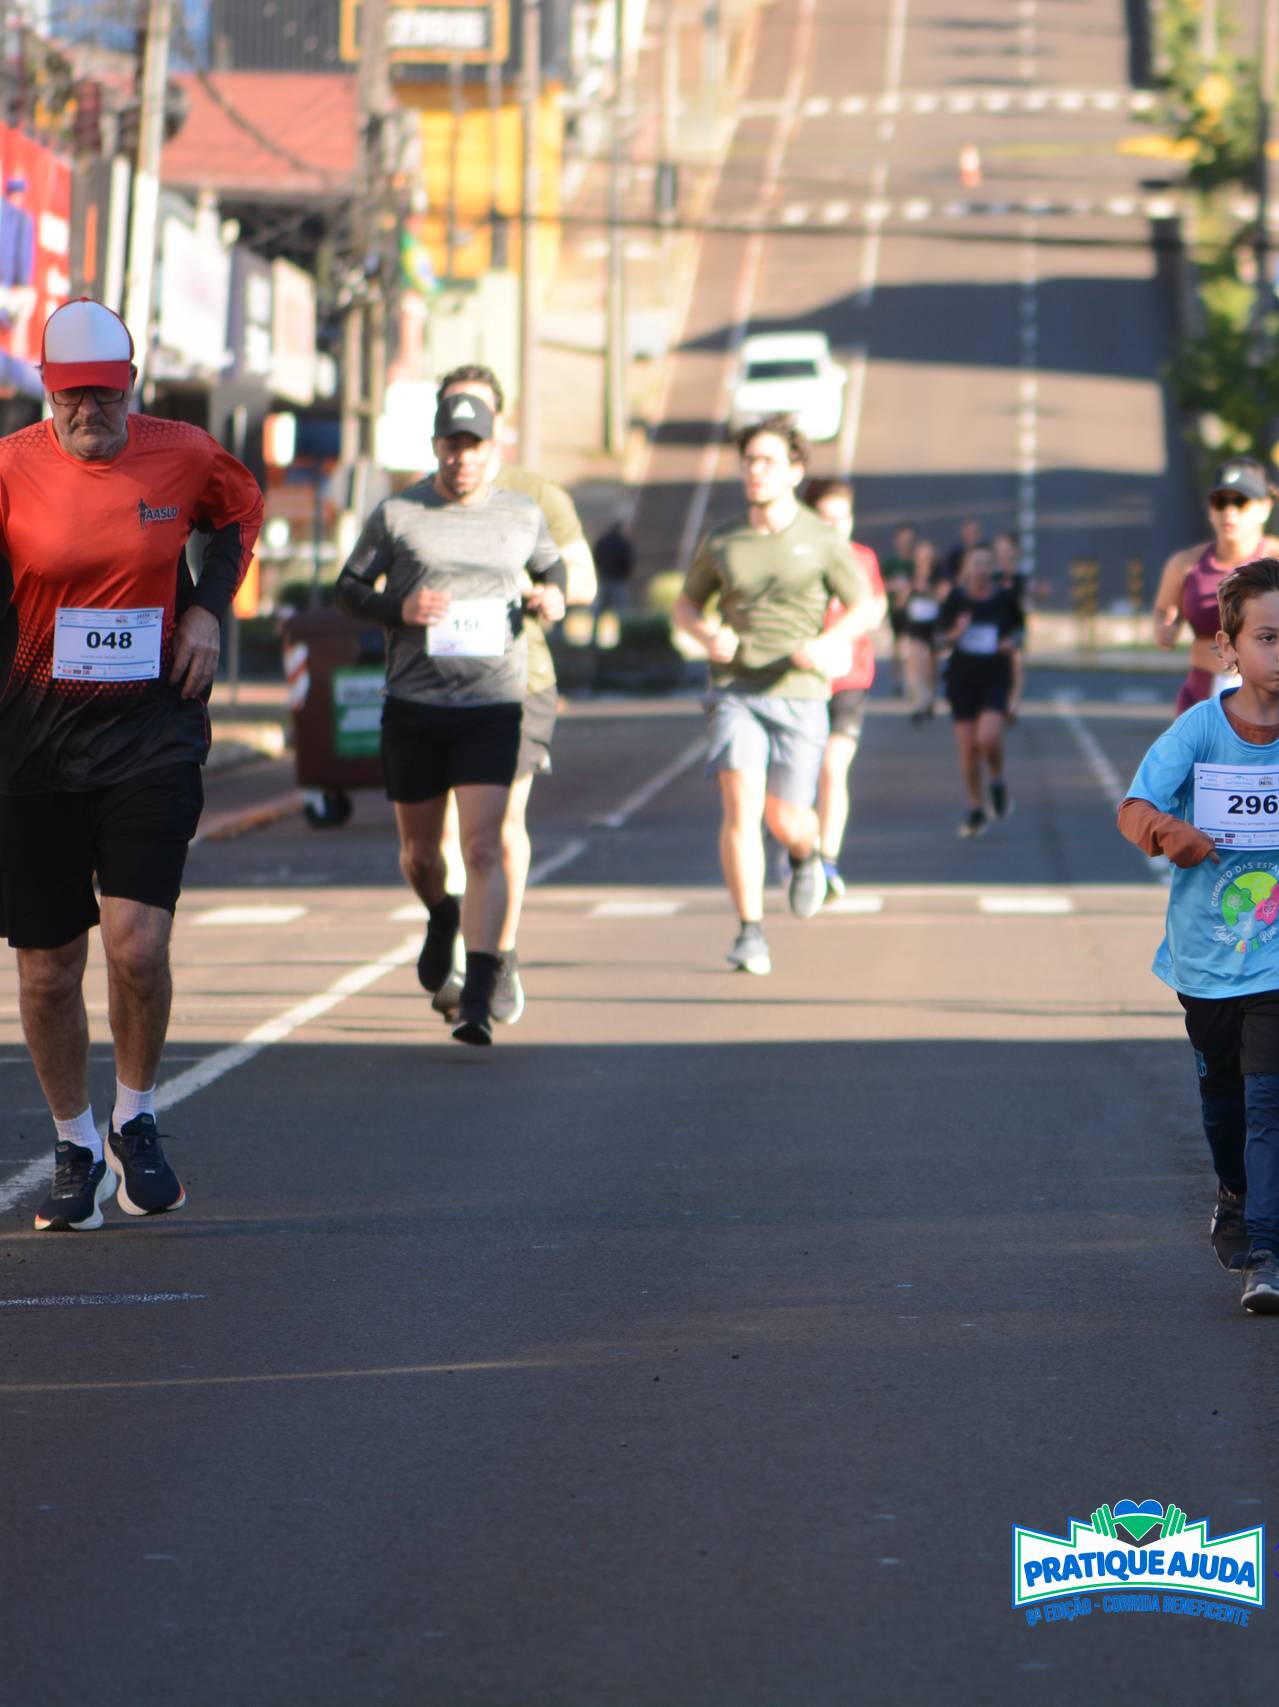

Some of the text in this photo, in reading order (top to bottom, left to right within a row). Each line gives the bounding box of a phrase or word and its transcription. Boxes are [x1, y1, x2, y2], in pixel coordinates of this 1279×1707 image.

[145, 506, 179, 521] AASLO
[86, 631, 132, 649] 048
[1228, 795, 1279, 815] 296
[1211, 870, 1233, 907] CIRCUITO
[1235, 862, 1253, 873] DAS
[1213, 925, 1238, 946] Night
[1259, 926, 1278, 944] Run
